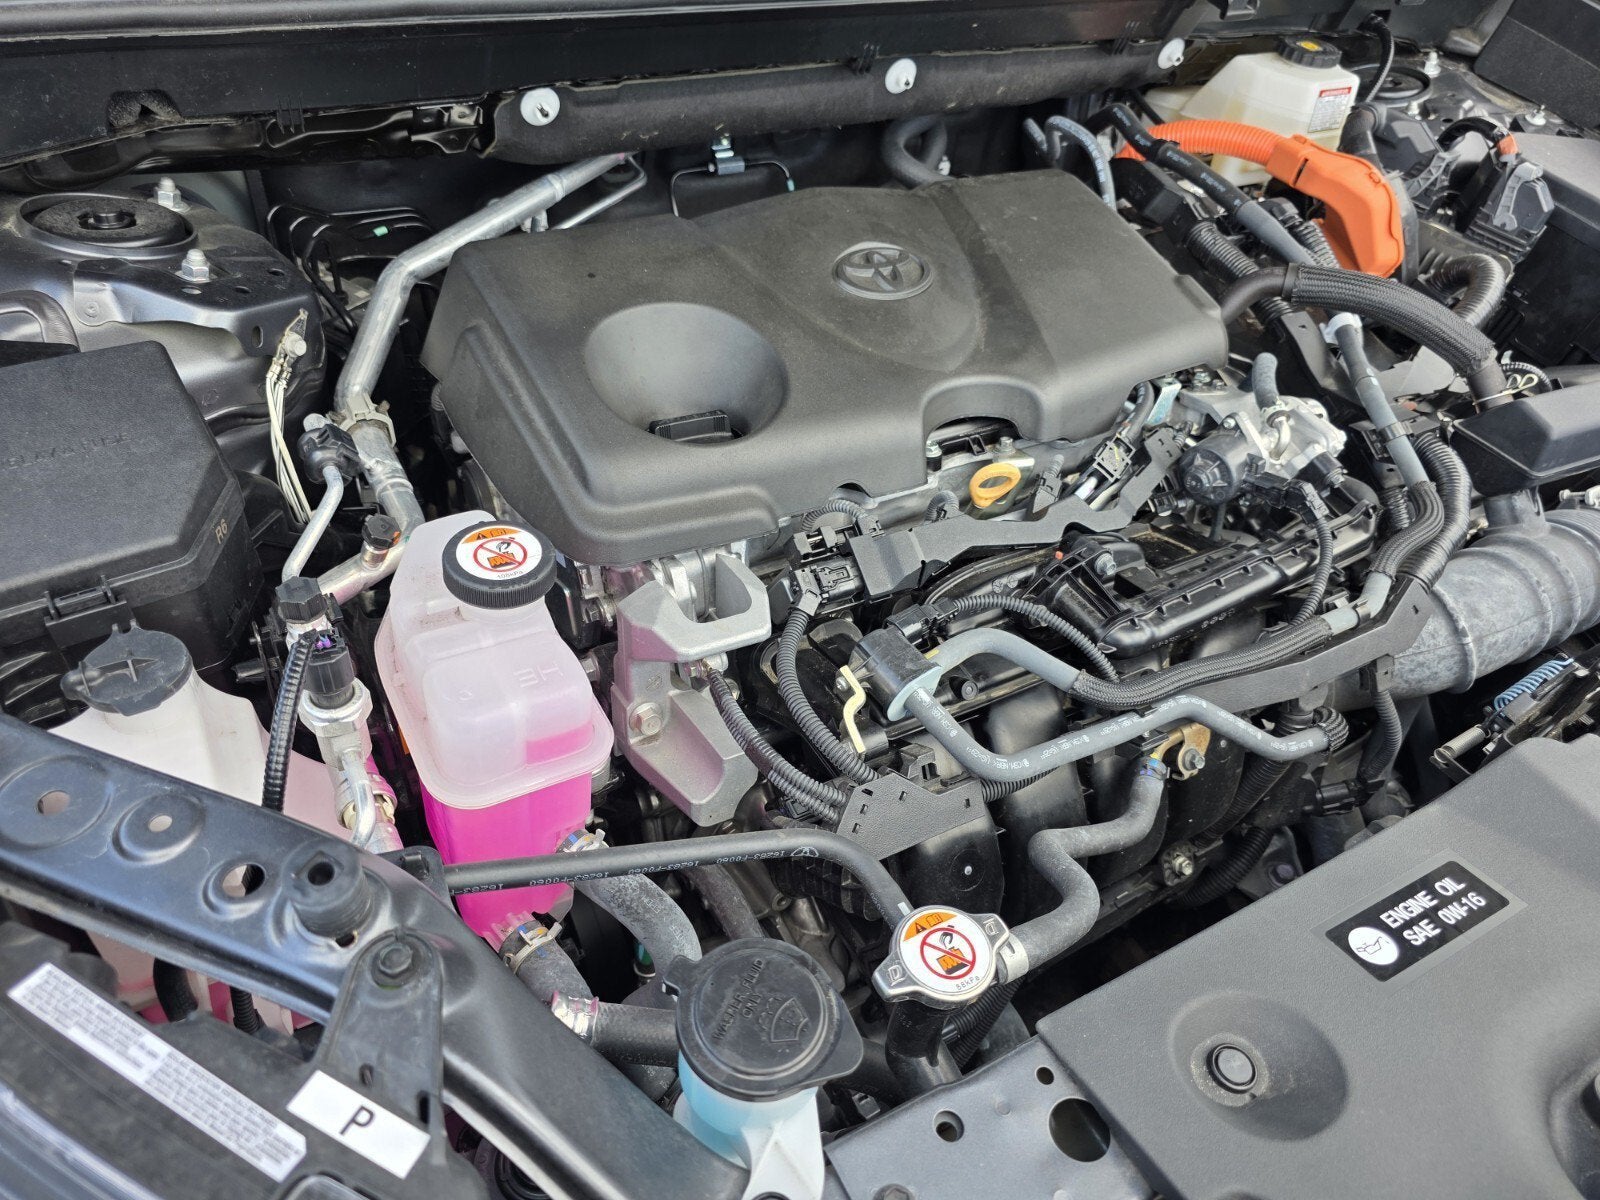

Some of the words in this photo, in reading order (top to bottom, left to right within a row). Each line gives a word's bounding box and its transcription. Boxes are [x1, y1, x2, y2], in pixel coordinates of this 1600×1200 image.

[215, 519, 229, 544] R6
[1379, 890, 1440, 929] ENGINE
[1434, 877, 1467, 897] OIL
[1403, 918, 1442, 946] SAE
[1437, 892, 1487, 925] 0W-16
[339, 1105, 374, 1135] P
